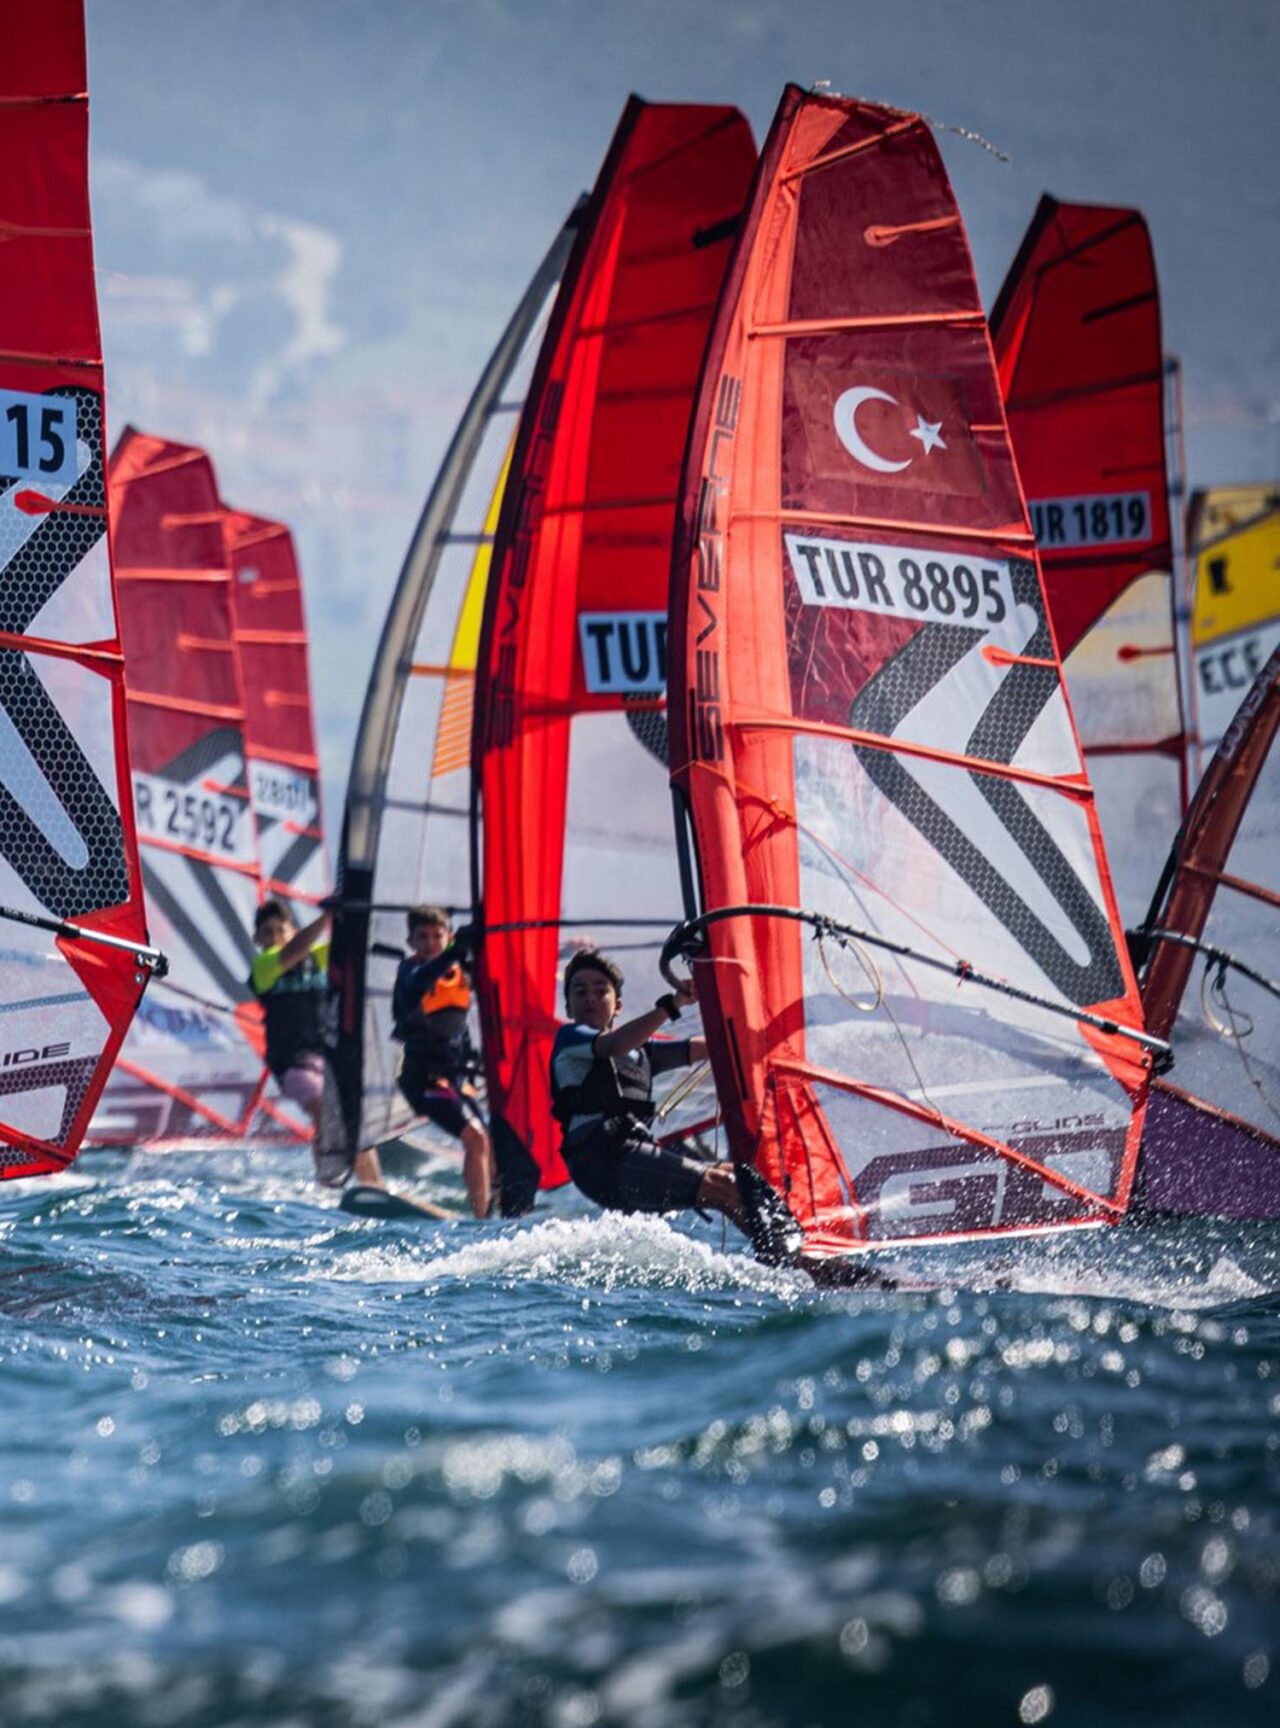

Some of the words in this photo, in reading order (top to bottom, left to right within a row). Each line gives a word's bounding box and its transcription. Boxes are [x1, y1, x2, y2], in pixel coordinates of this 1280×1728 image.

[1028, 502, 1066, 542] UR
[1072, 497, 1146, 540] 1819
[695, 374, 743, 761] SEVERNE
[796, 544, 895, 607] TUR
[898, 557, 1007, 624] 8895
[165, 789, 235, 852] 2592
[1011, 1112, 1105, 1134] GLIDE
